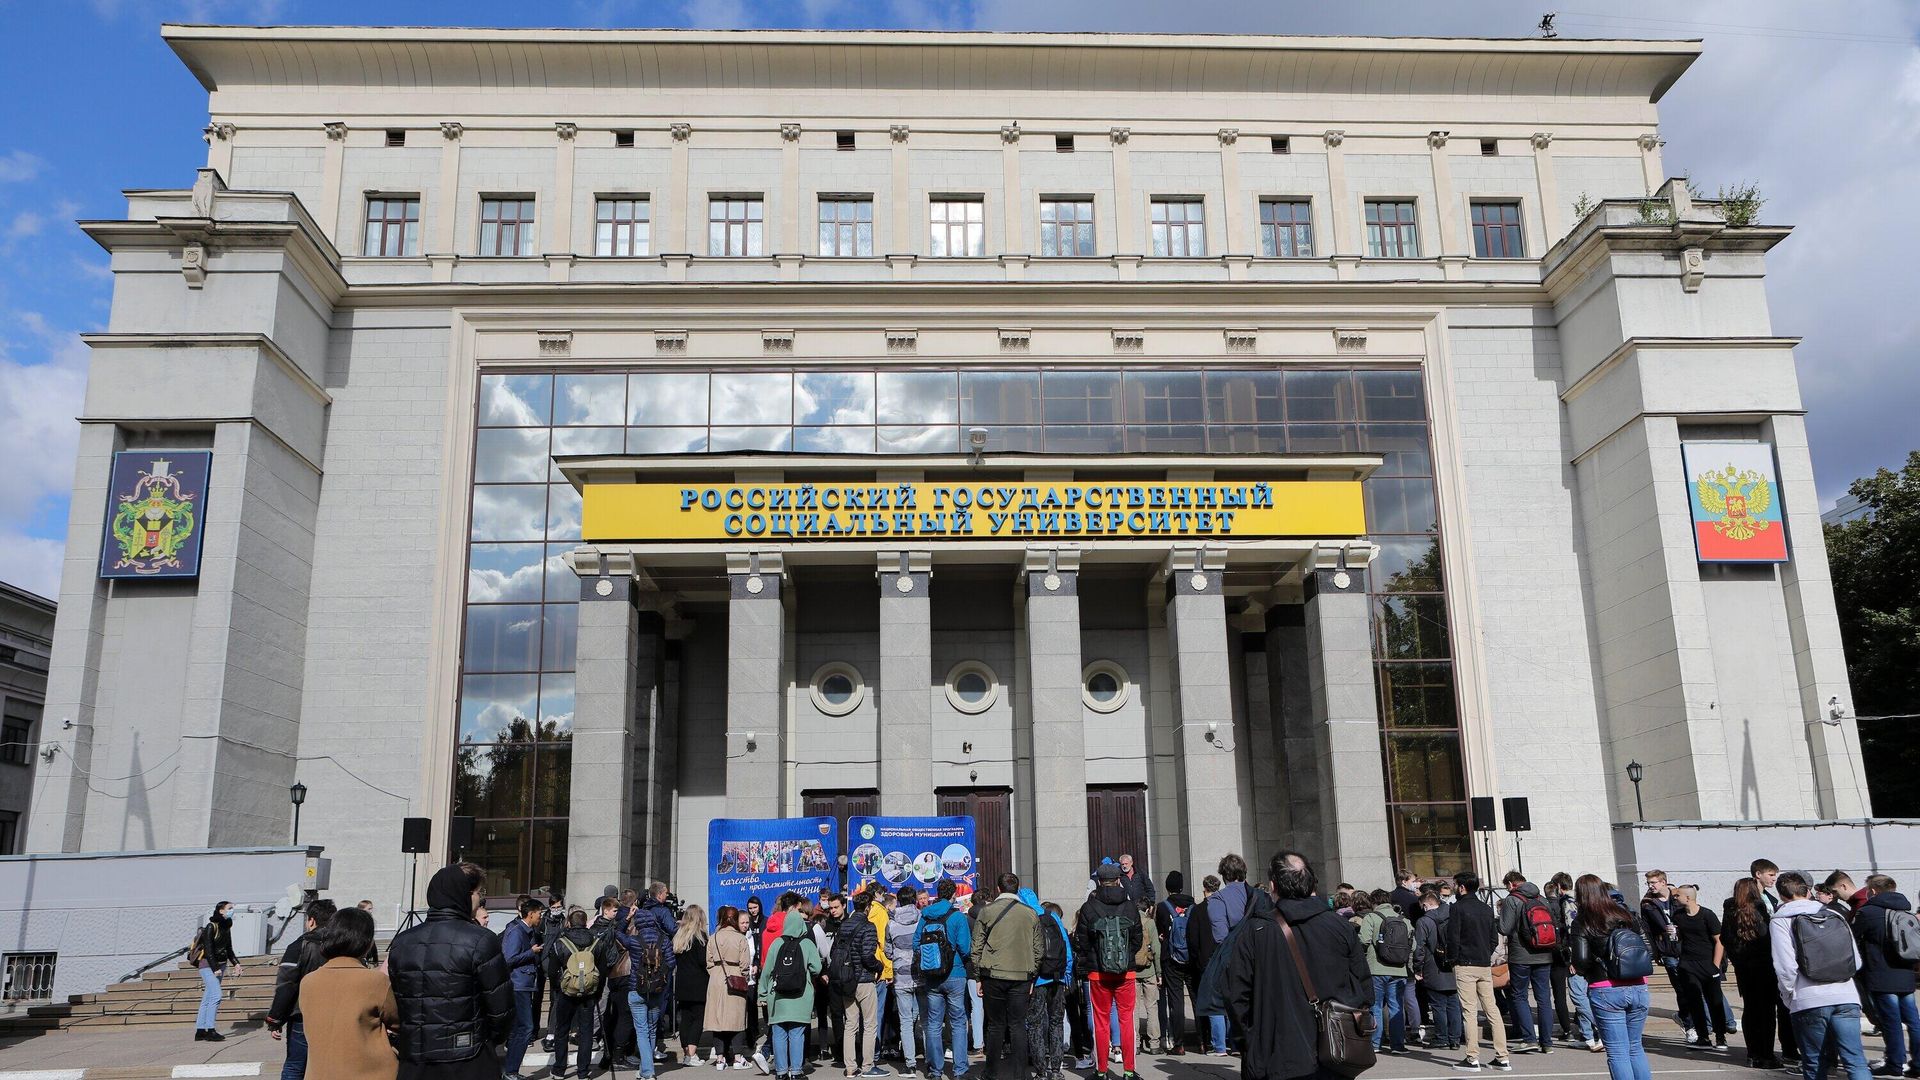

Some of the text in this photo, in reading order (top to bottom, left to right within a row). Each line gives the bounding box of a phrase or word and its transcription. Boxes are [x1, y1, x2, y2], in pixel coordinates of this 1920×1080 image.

[680, 482, 1274, 511] РОССИЙСКИЙ ГОСУДАРСТВЕННЫЙ
[724, 508, 1235, 537] СОЦИАЛЬНЫЙ УНИВЕРСИТЕТ
[717, 840, 831, 874] ЛИГА
[720, 874, 760, 886] качество
[749, 876, 822, 893] продолжительность
